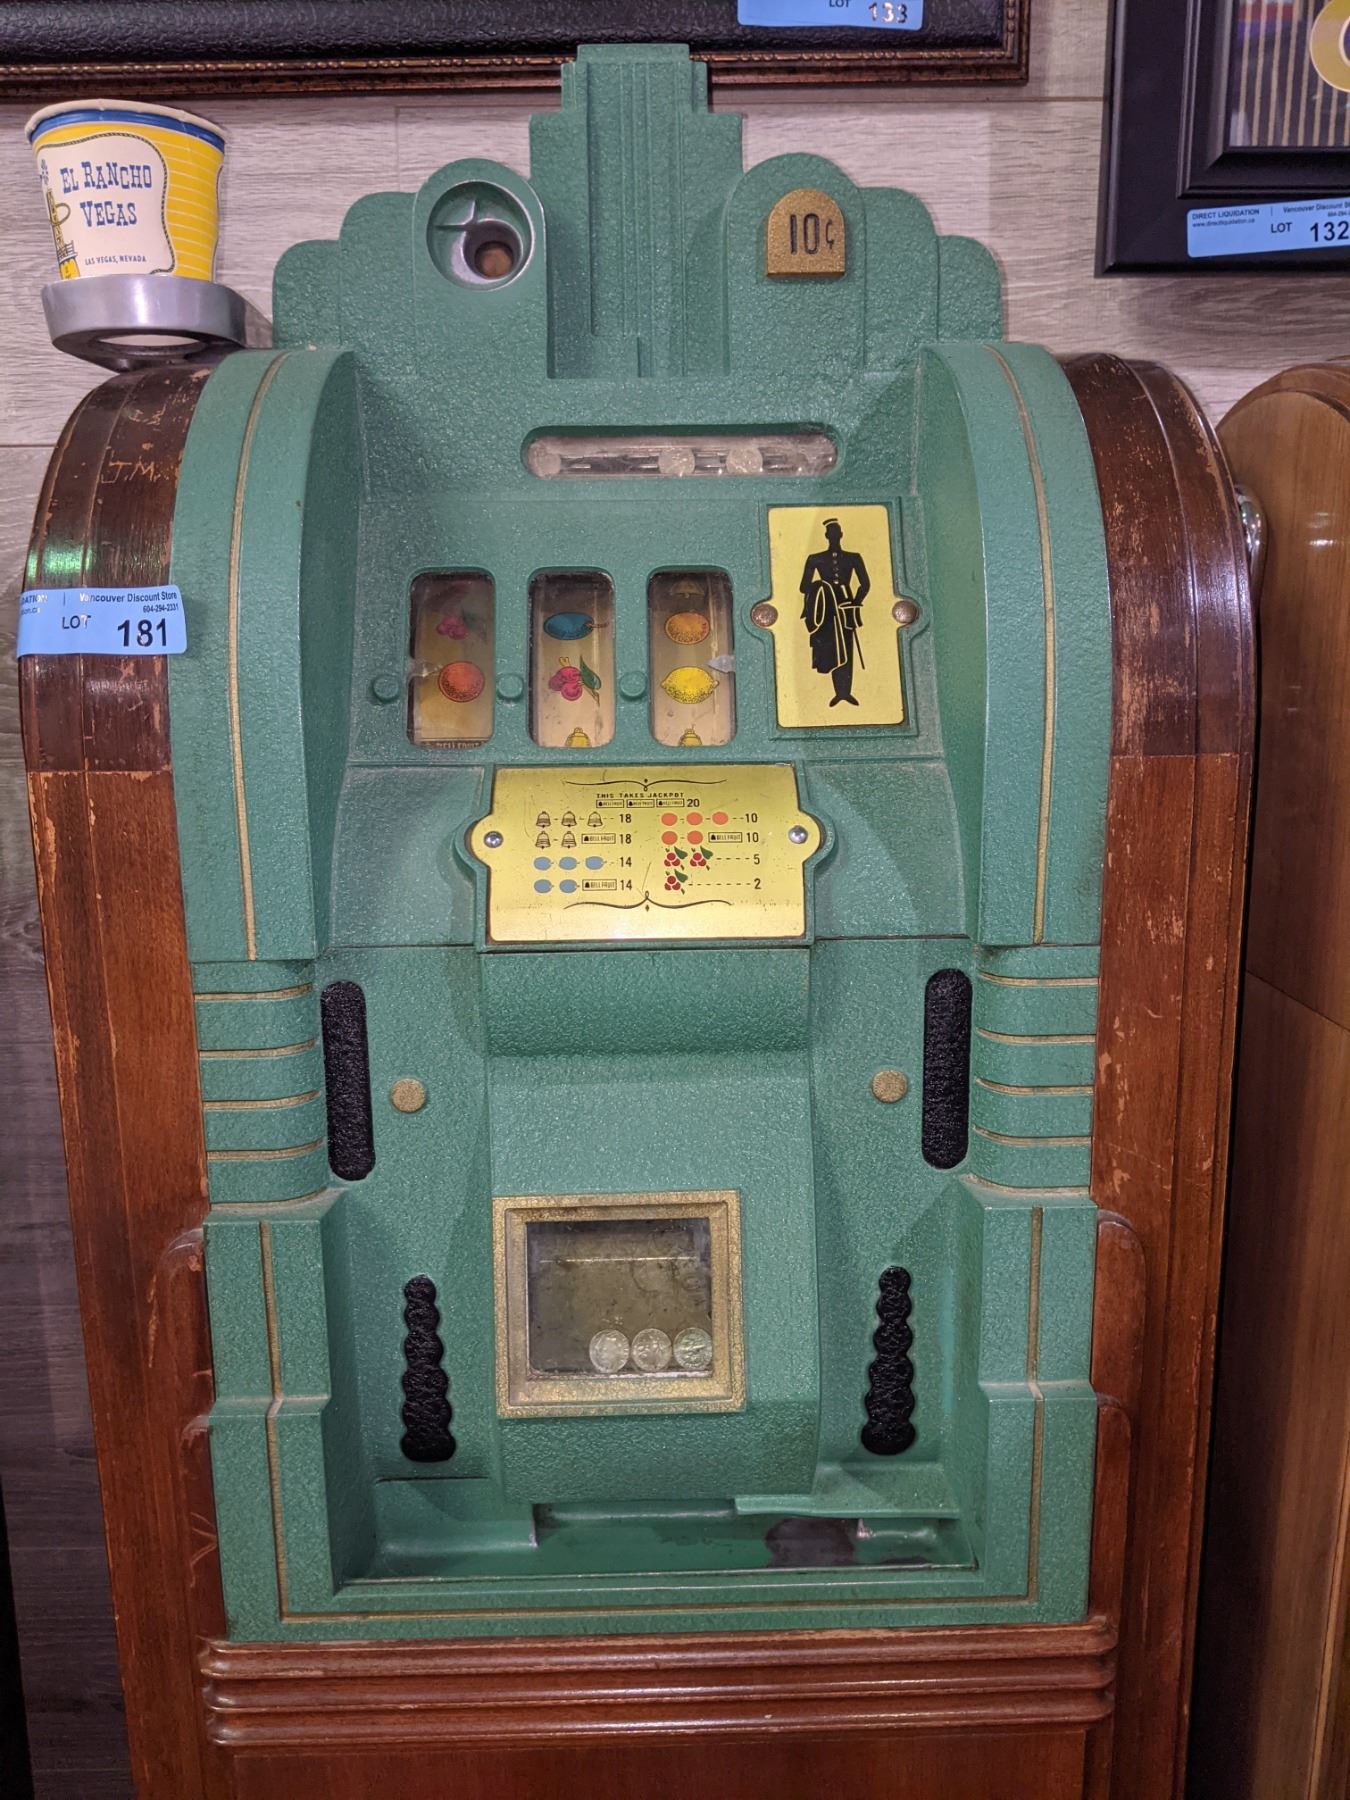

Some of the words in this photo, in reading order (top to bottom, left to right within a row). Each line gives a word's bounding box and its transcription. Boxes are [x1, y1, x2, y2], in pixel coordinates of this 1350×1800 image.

[868, 2, 908, 23] 133
[59, 167, 79, 194] EL
[81, 161, 153, 190] RANCHO
[80, 200, 138, 228] VEGAS
[1192, 211, 1216, 220] DIRECT
[1217, 208, 1260, 219] LIQUIDATION
[1271, 222, 1293, 234] LOT
[1310, 220, 1349, 242] 132
[84, 257, 95, 266] LAS
[96, 255, 118, 264] VEGAS,
[119, 255, 147, 263] NEVADA
[80, 593, 125, 603] Vancouver
[127, 592, 160, 602] Discount
[161, 591, 178, 600] Store
[62, 614, 92, 630] LOT
[117, 618, 167, 647] 181
[686, 799, 700, 808] 20
[619, 813, 632, 824] 18
[745, 813, 758, 823] 10
[619, 833, 632, 844] 18
[746, 832, 759, 843] 10
[619, 856, 632, 868] 14
[753, 853, 761, 865] 5
[620, 879, 633, 891] 14
[754, 878, 761, 890] 2
